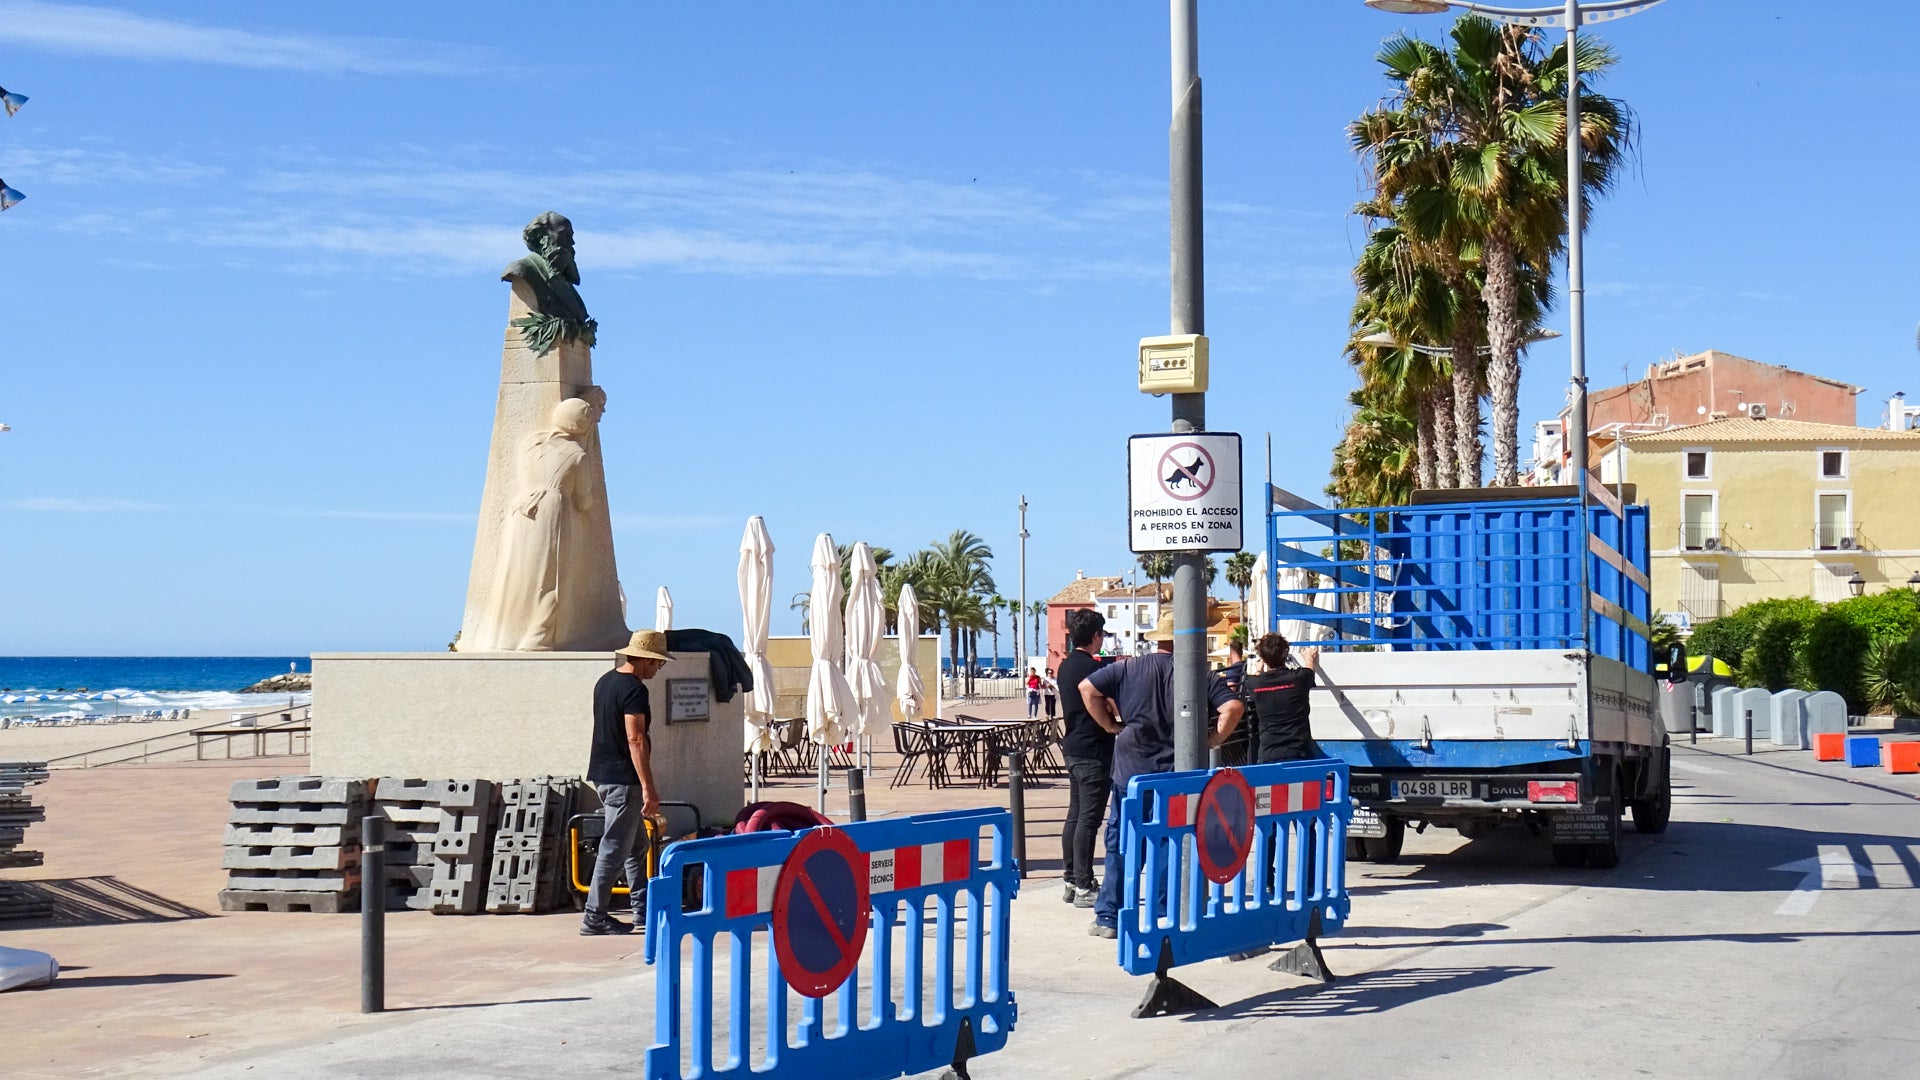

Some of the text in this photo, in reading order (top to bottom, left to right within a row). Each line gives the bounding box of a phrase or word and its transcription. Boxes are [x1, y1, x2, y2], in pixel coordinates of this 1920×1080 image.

[1134, 507, 1238, 517] PROHIBIDO EL ACCESO
[1140, 521, 1232, 531] A PERROS EN ZONA
[1166, 533, 1208, 544] DE BAÑO
[1400, 781, 1468, 796] 0498 LBR
[1556, 822, 1606, 830] INDUSTRIALES
[871, 858, 893, 869] SERVEIS
